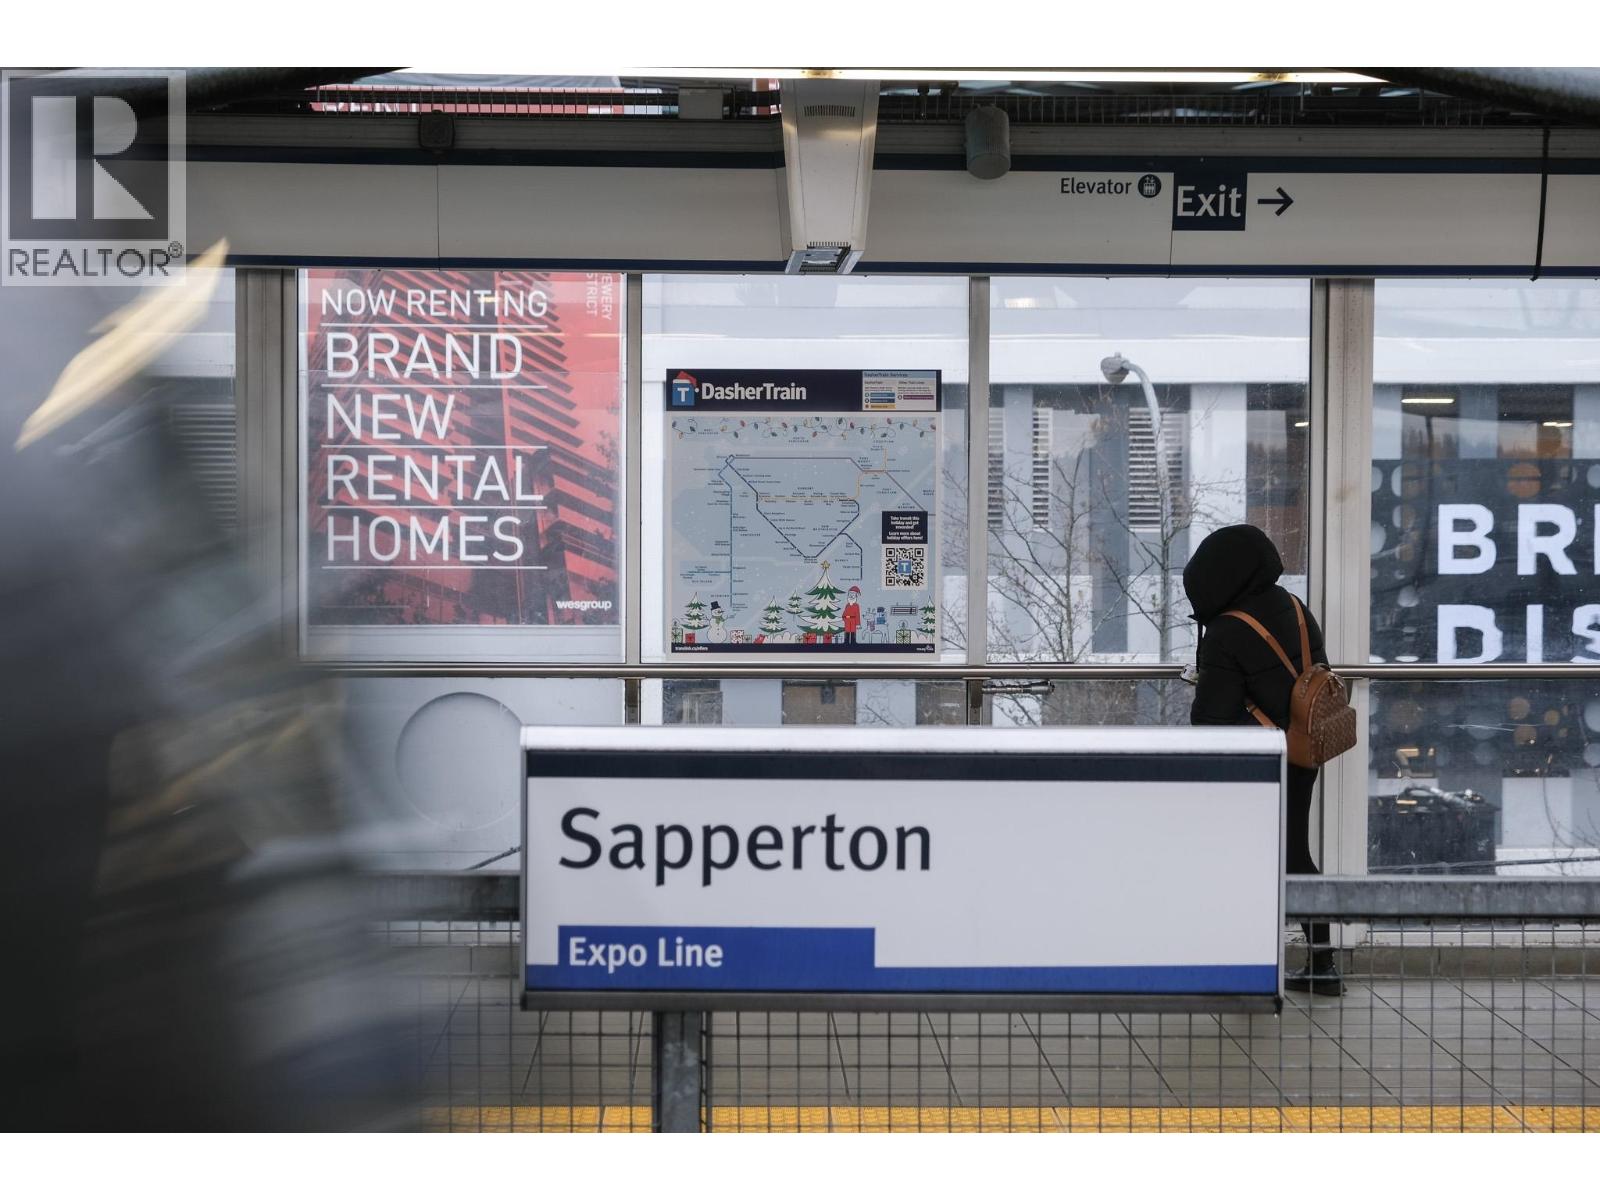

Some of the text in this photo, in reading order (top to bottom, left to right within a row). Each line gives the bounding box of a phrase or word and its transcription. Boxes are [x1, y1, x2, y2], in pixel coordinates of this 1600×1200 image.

[1060, 177, 1132, 195] Elevator
[1177, 184, 1242, 217] Exit
[321, 288, 548, 318] NOW RENTING
[601, 273, 613, 321] EWERY
[326, 332, 523, 380] BRAND
[701, 382, 807, 400] DasherTrain
[327, 394, 455, 441] NEW
[327, 455, 544, 501] RENTAL
[327, 515, 524, 562] HOMES
[1438, 503, 1600, 576] BR
[555, 600, 613, 611] wesgroup
[558, 806, 932, 888] Sapperton
[569, 936, 724, 975] Expo Line
